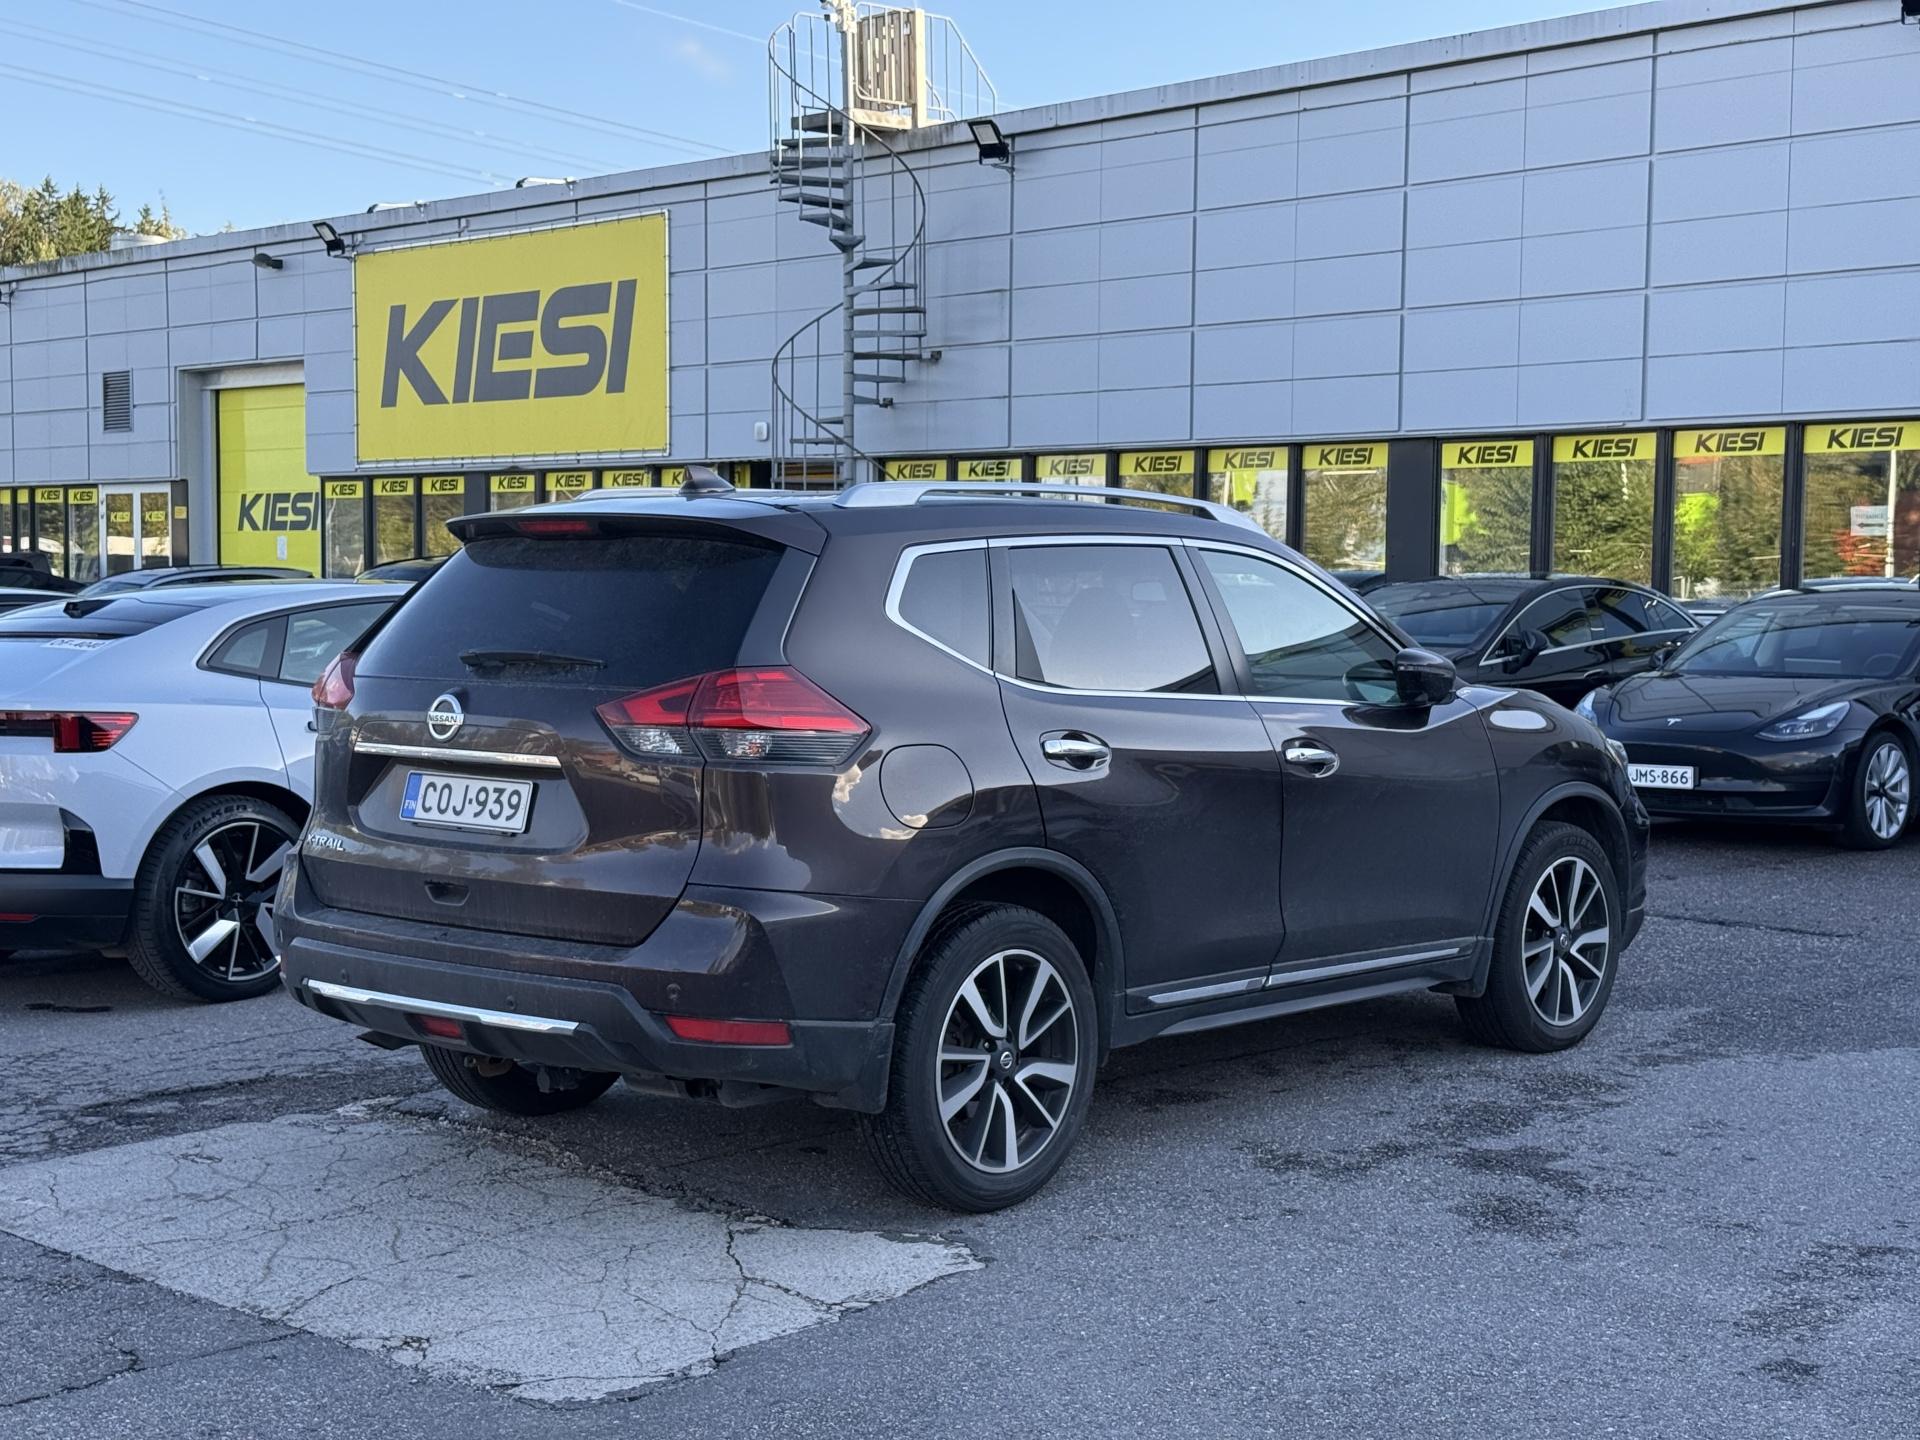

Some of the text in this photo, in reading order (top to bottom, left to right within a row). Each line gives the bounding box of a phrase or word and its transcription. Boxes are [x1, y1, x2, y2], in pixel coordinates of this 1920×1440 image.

[381, 279, 637, 408] KIESI
[1695, 431, 1766, 453] KIESI
[1827, 426, 1904, 449] KIESI
[1318, 447, 1374, 466] KIESI
[1457, 445, 1519, 465] KIESI
[1572, 438, 1638, 459] KIESI
[1050, 459, 1095, 475] KIESI
[1134, 456, 1182, 472] KIESI
[1224, 451, 1275, 469] KIESI
[897, 464, 937, 479] KIESI
[968, 461, 1011, 477] KIESI
[381, 480, 408, 493] KIESI
[431, 479, 459, 491] KIESI
[498, 476, 527, 489] KIESI
[555, 473, 586, 487] KIESI
[612, 472, 645, 487] KIESI
[331, 484, 357, 496] KIESI
[238, 492, 319, 531] KIESI
[429, 713, 458, 723] NISSAN
[1631, 768, 1689, 785] JMS-866
[404, 800, 417, 811] FIN
[421, 781, 522, 822] COJ-939
[308, 834, 344, 851] X-TRAIL
